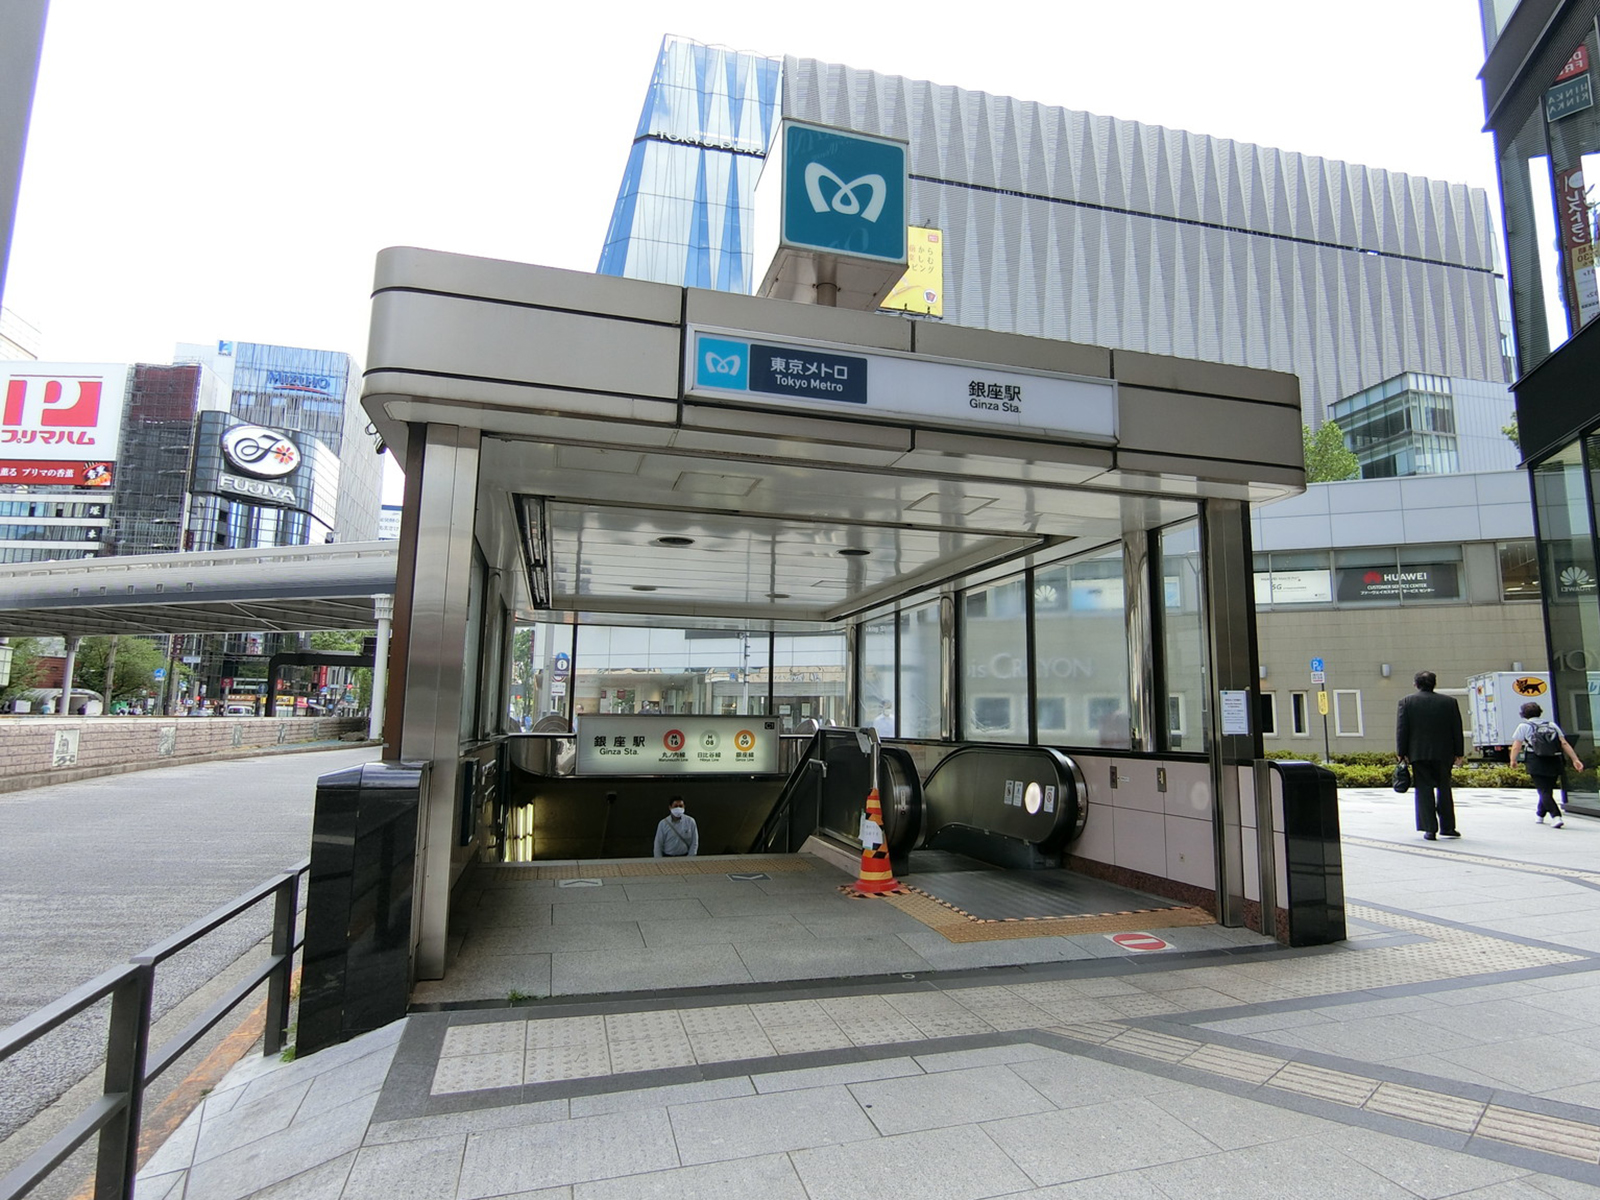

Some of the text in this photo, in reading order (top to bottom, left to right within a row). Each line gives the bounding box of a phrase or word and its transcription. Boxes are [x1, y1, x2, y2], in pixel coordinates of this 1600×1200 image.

[718, 140, 766, 156] PLAZ
[770, 357, 848, 380] 東京メトロ
[268, 370, 331, 389] MIZUHO
[775, 374, 844, 392] Tokyo Metro
[968, 380, 1021, 402] 銀座駅
[969, 398, 1021, 413] Ginza Sta.
[1, 429, 96, 445] プリマハム
[220, 475, 296, 501] FUJIYA
[1383, 572, 1427, 581] HUAWEI
[989, 652, 1094, 679] CRYON
[594, 735, 645, 747] 銀座駅
